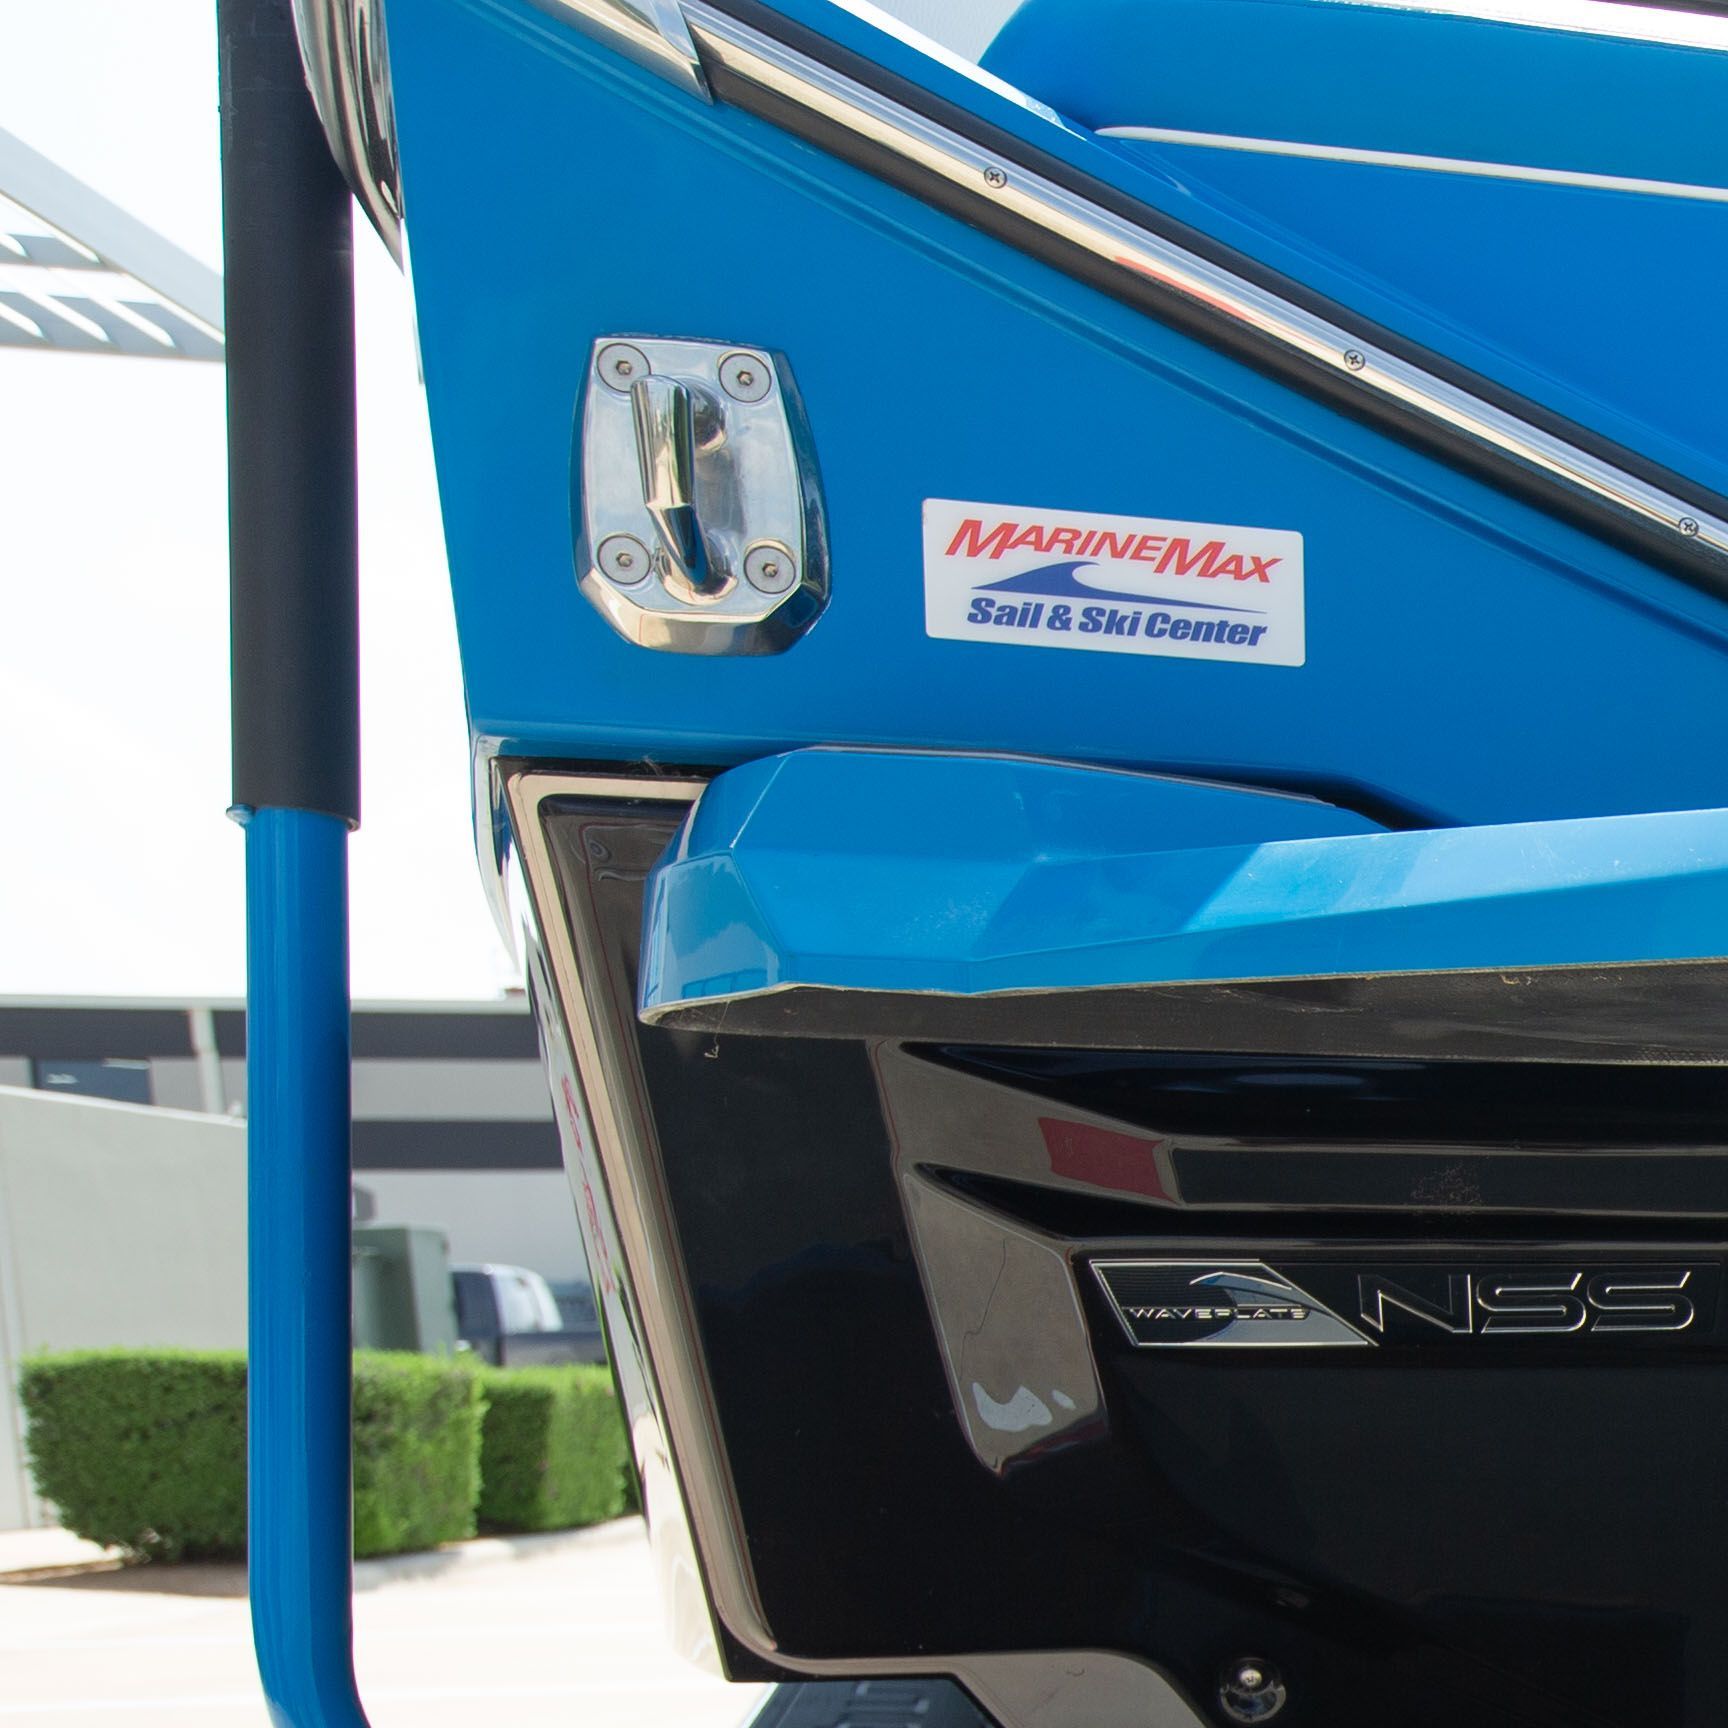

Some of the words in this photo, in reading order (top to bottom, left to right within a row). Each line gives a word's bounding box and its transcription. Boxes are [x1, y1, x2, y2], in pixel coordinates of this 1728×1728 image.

[967, 597, 1042, 630] Sail
[1046, 604, 1073, 631] &
[1078, 605, 1140, 637] Ski
[1144, 612, 1268, 647] Center
[1129, 1307, 1307, 1320] WAVEPLATE
[1356, 1272, 1695, 1335] NSS
